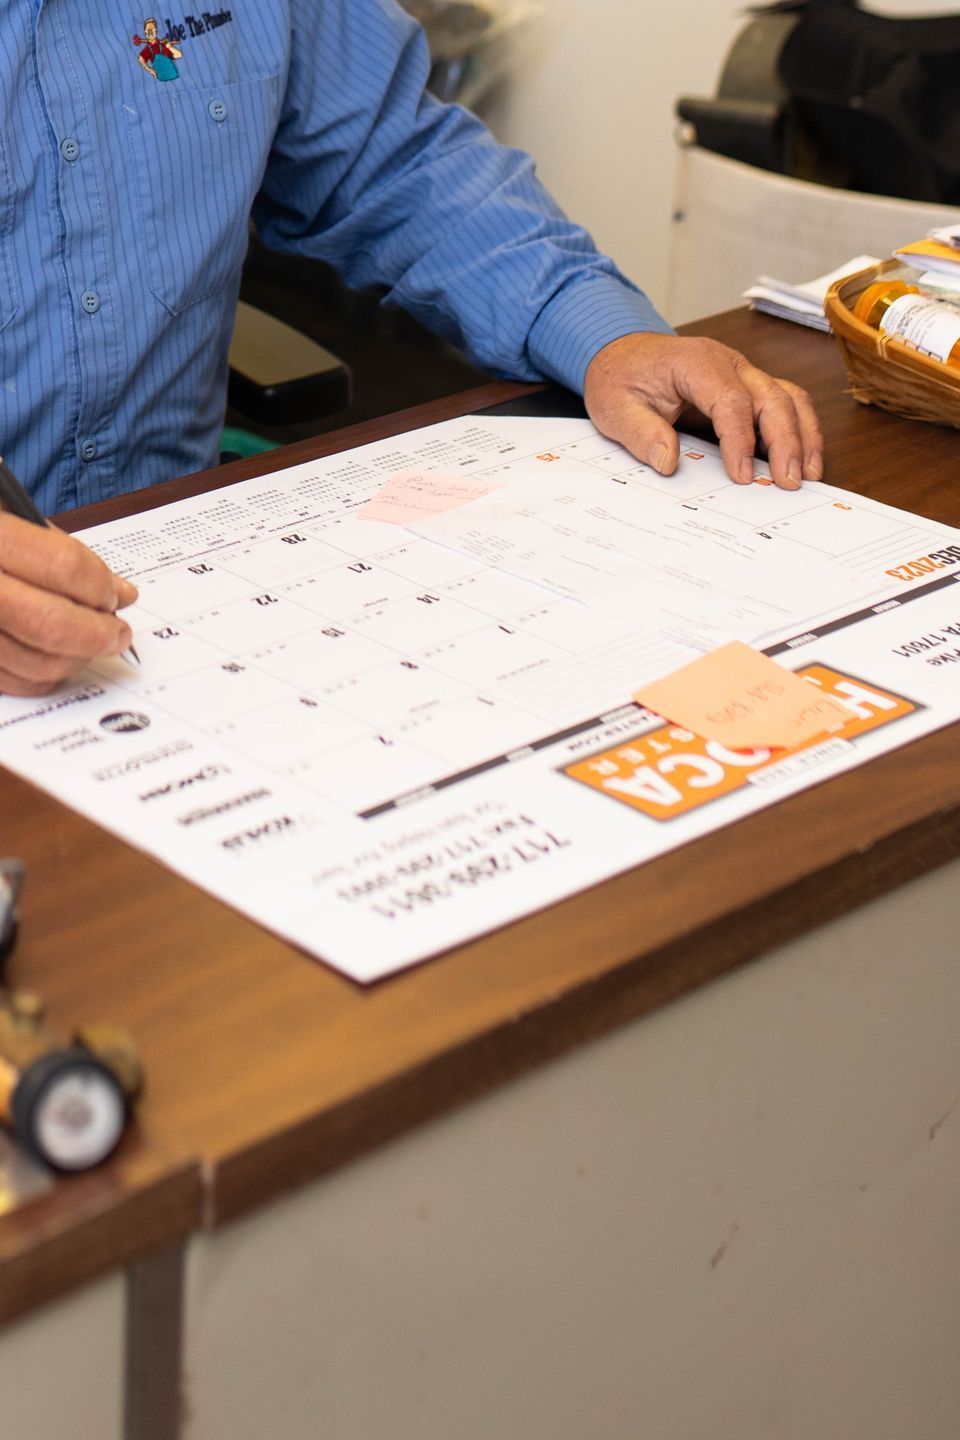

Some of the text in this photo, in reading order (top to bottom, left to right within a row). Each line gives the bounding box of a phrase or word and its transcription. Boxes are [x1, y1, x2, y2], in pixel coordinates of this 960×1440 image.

[165, 19, 186, 41] Joe
[185, 15, 205, 38] The
[536, 453, 560, 462] 25
[281, 534, 306, 544] 28
[188, 564, 213, 574] 29
[347, 563, 372, 573] 21
[252, 595, 278, 605] 22
[416, 594, 439, 604] 14
[153, 628, 179, 638] 23
